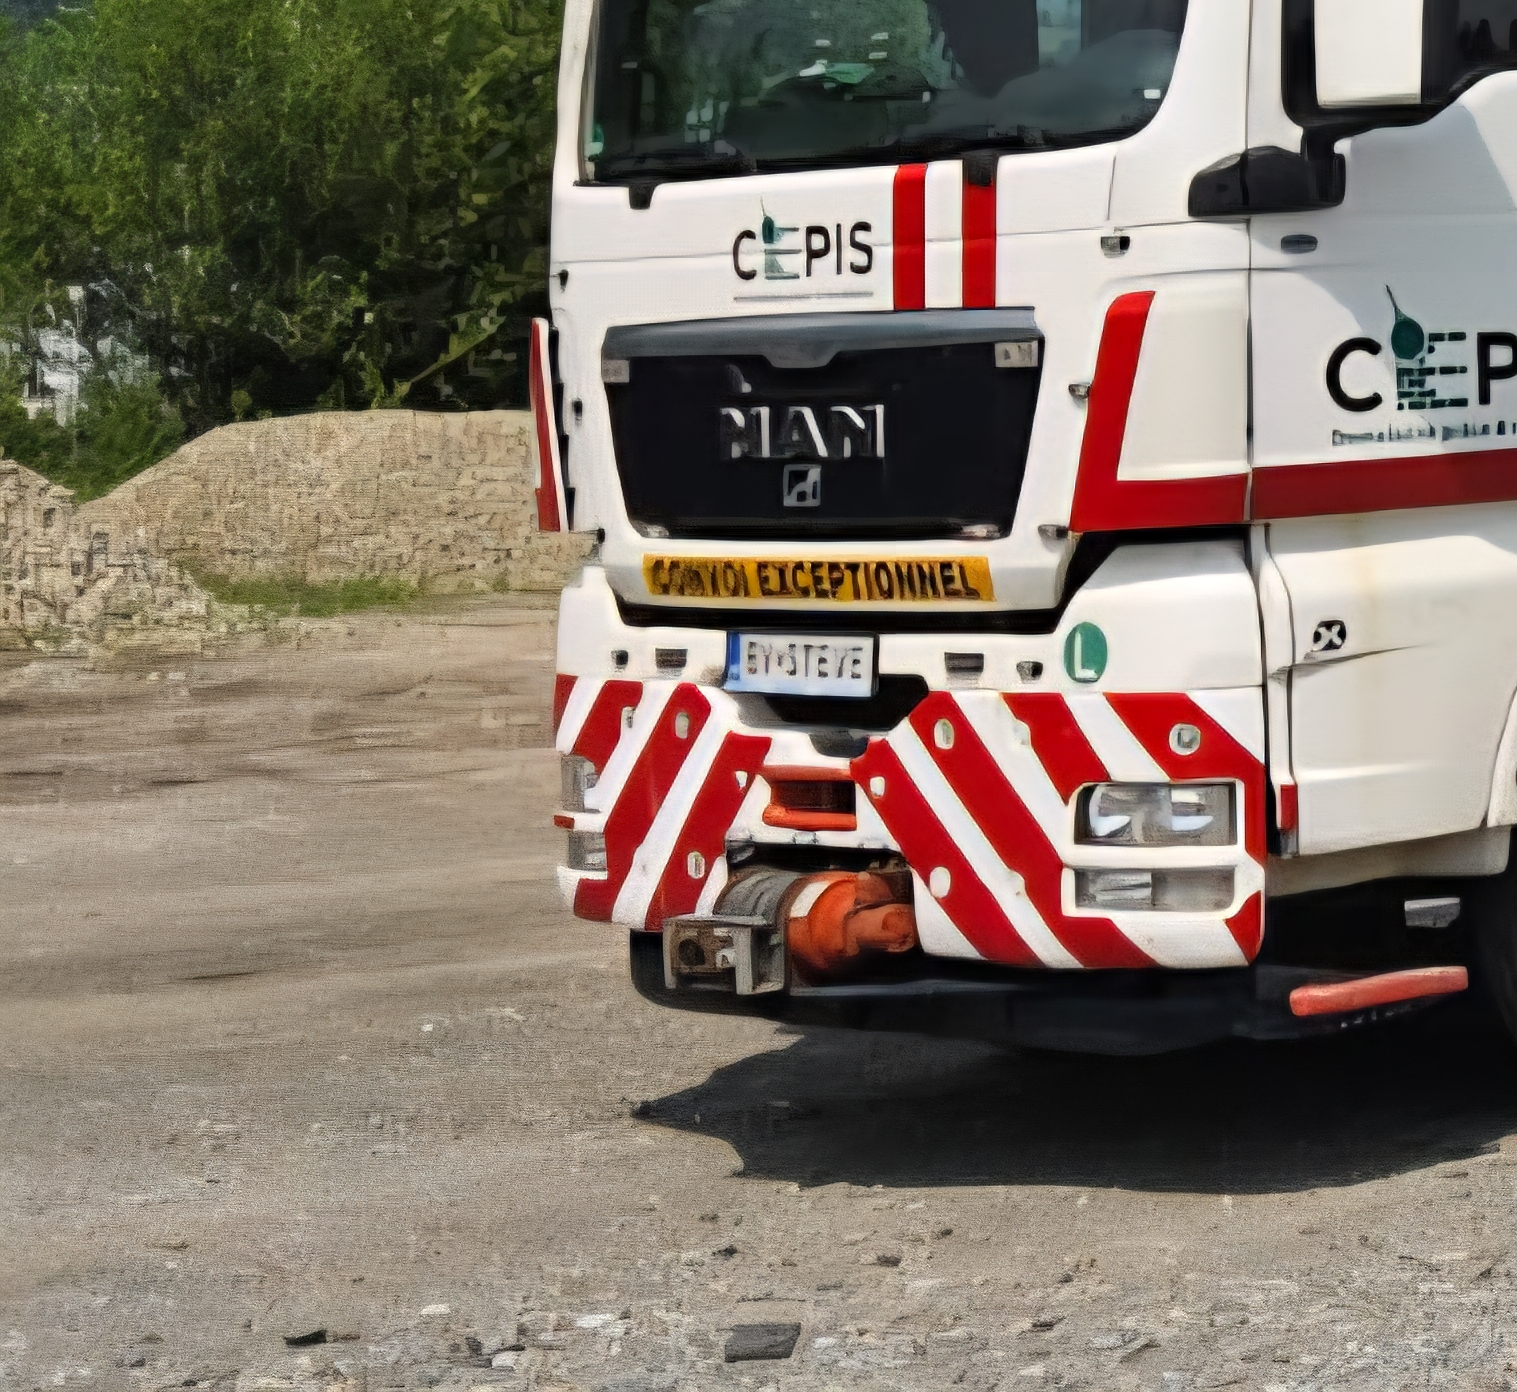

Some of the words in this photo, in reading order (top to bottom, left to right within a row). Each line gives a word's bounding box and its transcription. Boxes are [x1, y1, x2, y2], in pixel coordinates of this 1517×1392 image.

[732, 219, 874, 282] CEPIS
[719, 403, 886, 460] MAN
[1072, 627, 1099, 679] L
